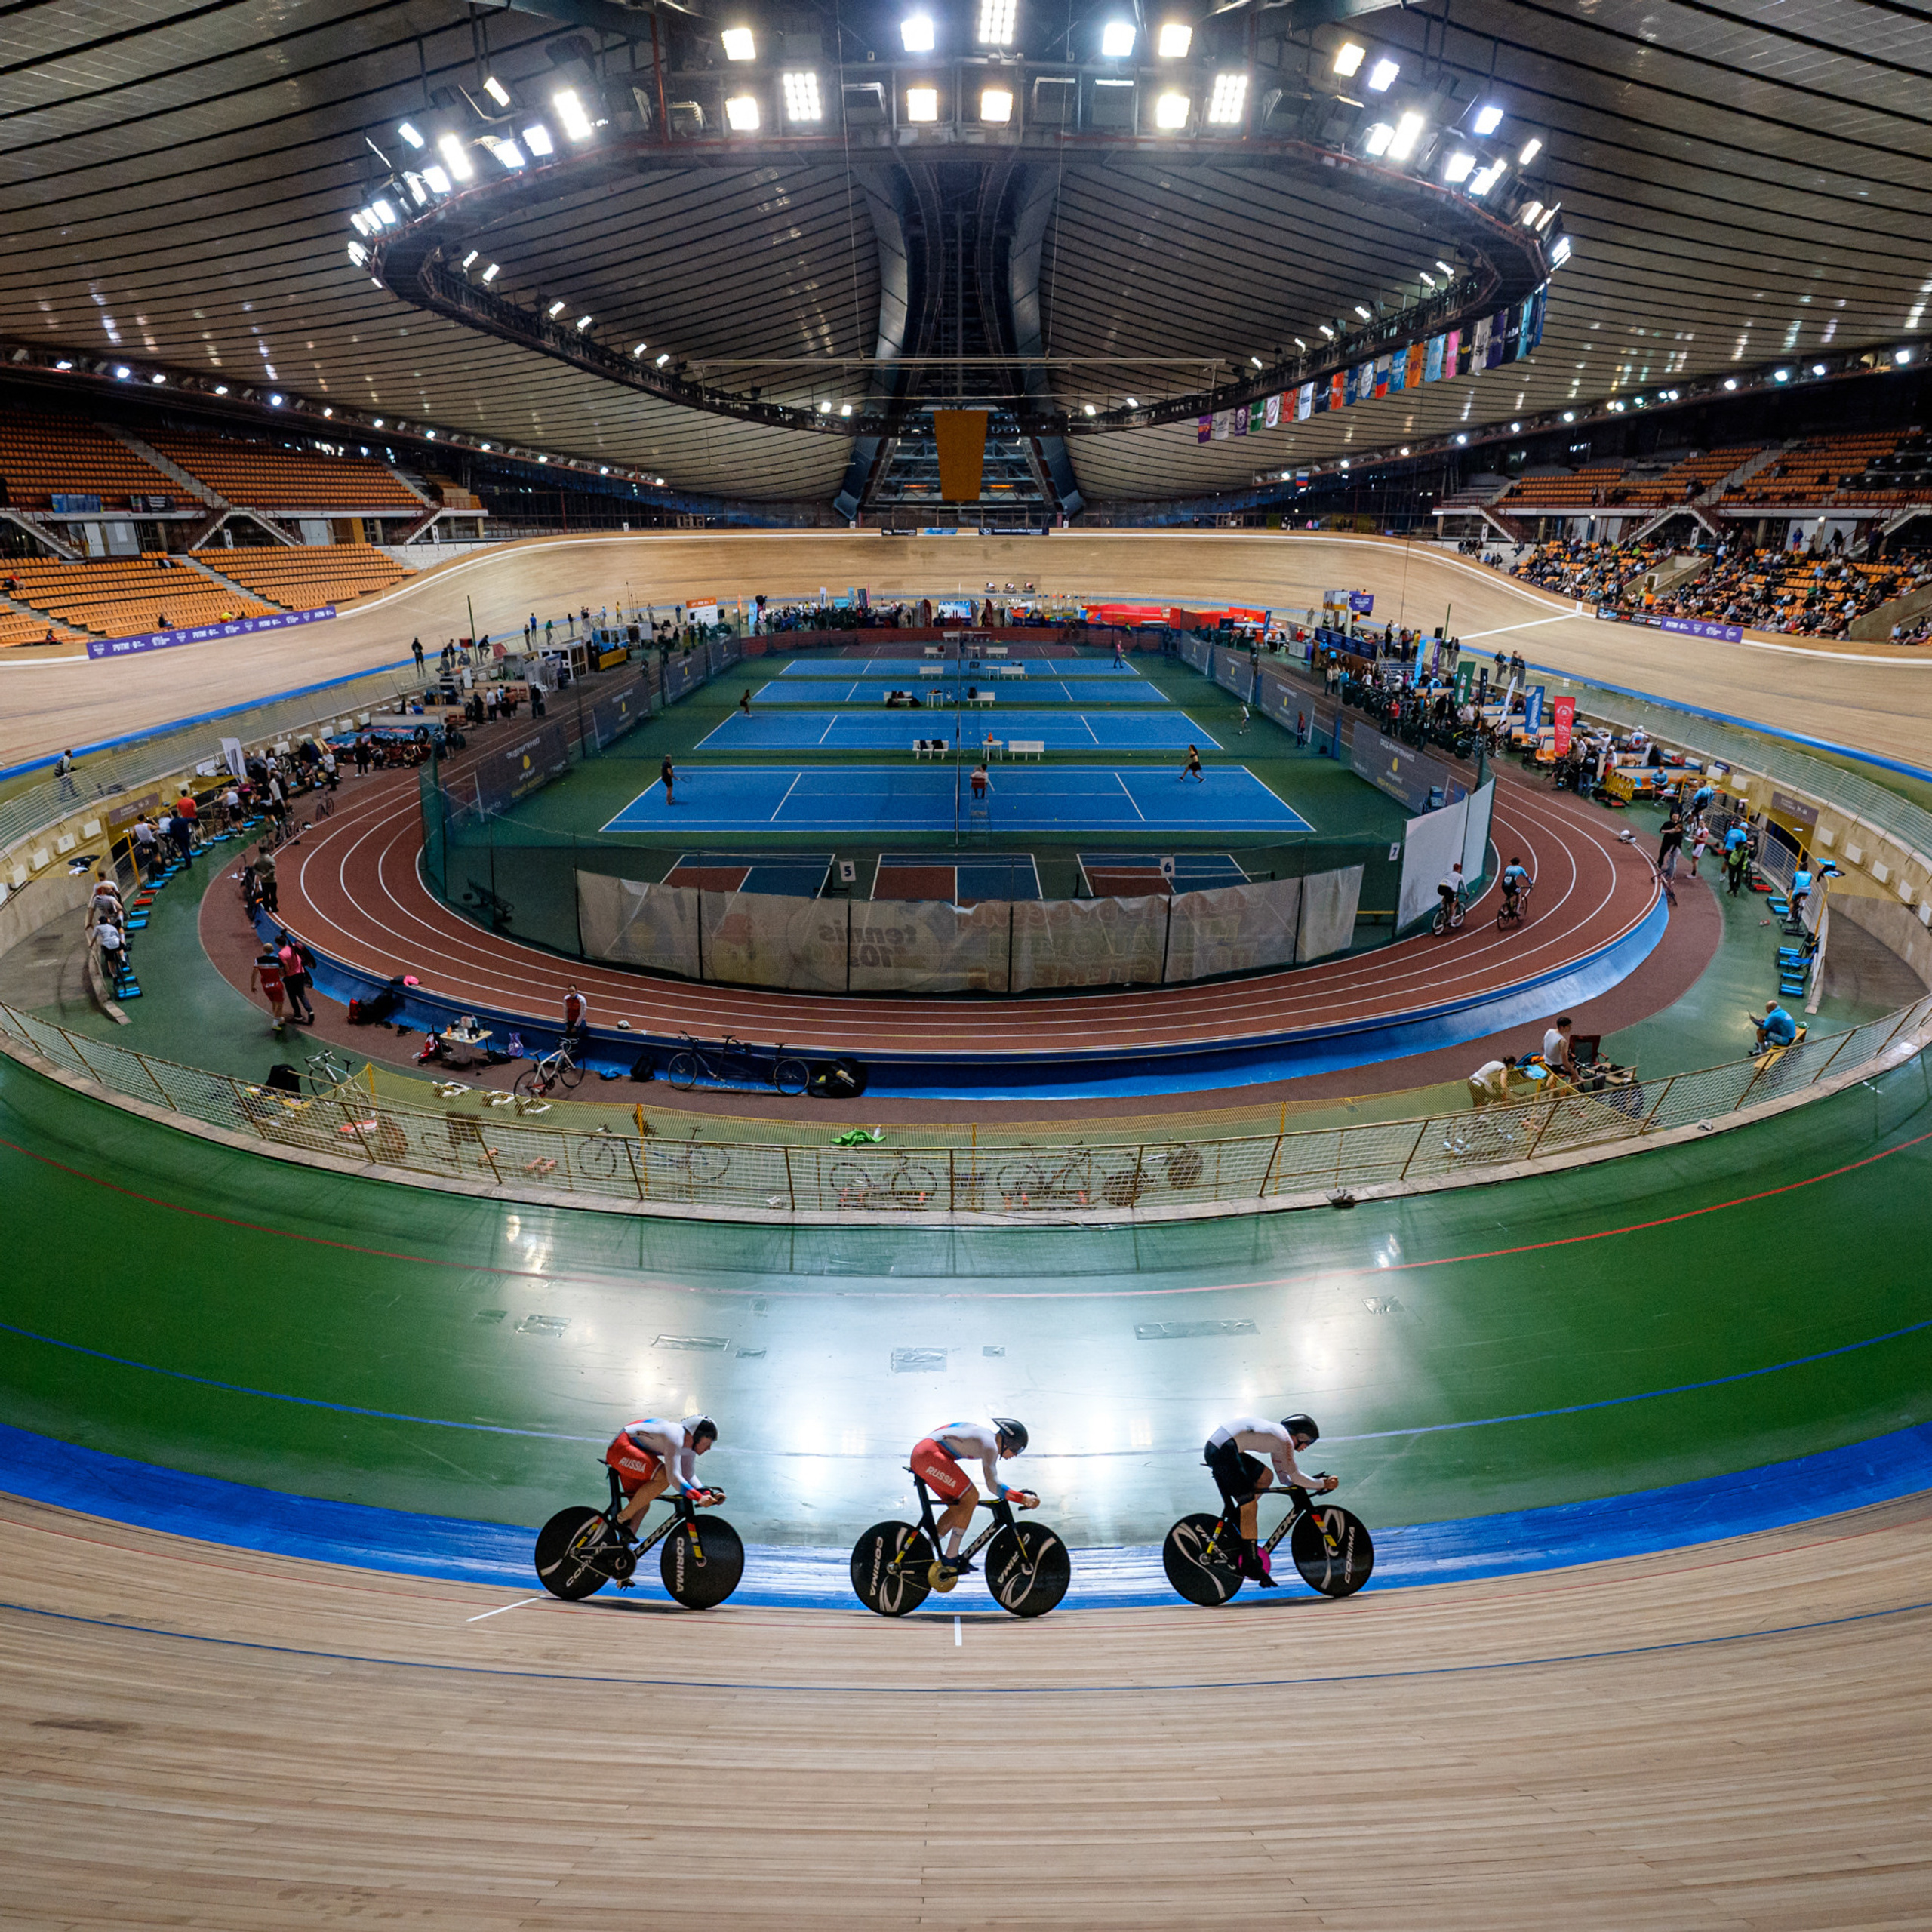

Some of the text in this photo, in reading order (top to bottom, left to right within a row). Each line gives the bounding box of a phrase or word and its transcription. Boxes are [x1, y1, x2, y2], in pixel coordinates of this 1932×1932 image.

[844, 866, 852, 877] 5
[1164, 861, 1172, 873] 6
[619, 1457, 647, 1473] RUSSIA
[925, 1466, 956, 1489] RUSSIA
[635, 1512, 679, 1555] LOOK
[963, 1522, 996, 1559] OOK
[1264, 1509, 1298, 1554] LOOK
[676, 1537, 685, 1592] CORIMA
[870, 1536, 884, 1596] CORIMA
[997, 1532, 1031, 1584] CRIMA
[1345, 1526, 1355, 1584] CORIMA
